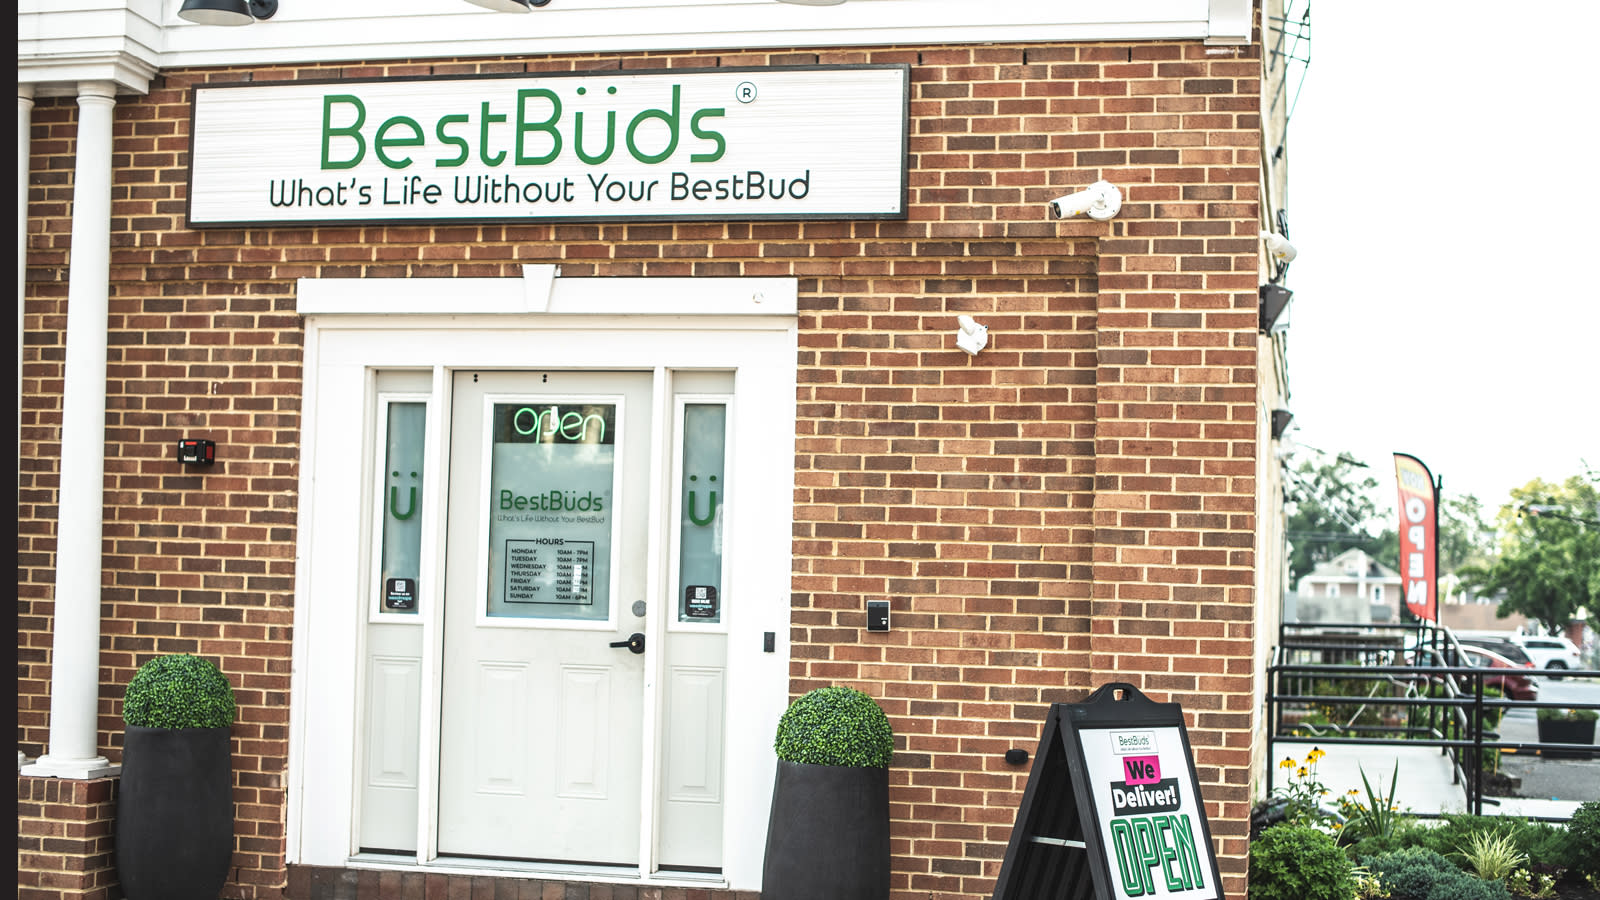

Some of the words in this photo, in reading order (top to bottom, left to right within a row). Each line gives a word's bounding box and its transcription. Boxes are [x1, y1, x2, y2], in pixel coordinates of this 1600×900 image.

[321, 84, 726, 170] BestBüds
[269, 177, 372, 207] What's
[383, 175, 442, 205] Life
[453, 174, 575, 204] Without
[587, 173, 659, 202] Your
[670, 169, 810, 201] BestBud
[514, 407, 605, 444] open
[500, 489, 603, 512] BestBüds
[1126, 760, 1155, 780] We
[1112, 784, 1178, 809] Deliver!
[1110, 814, 1205, 898] OPEN
